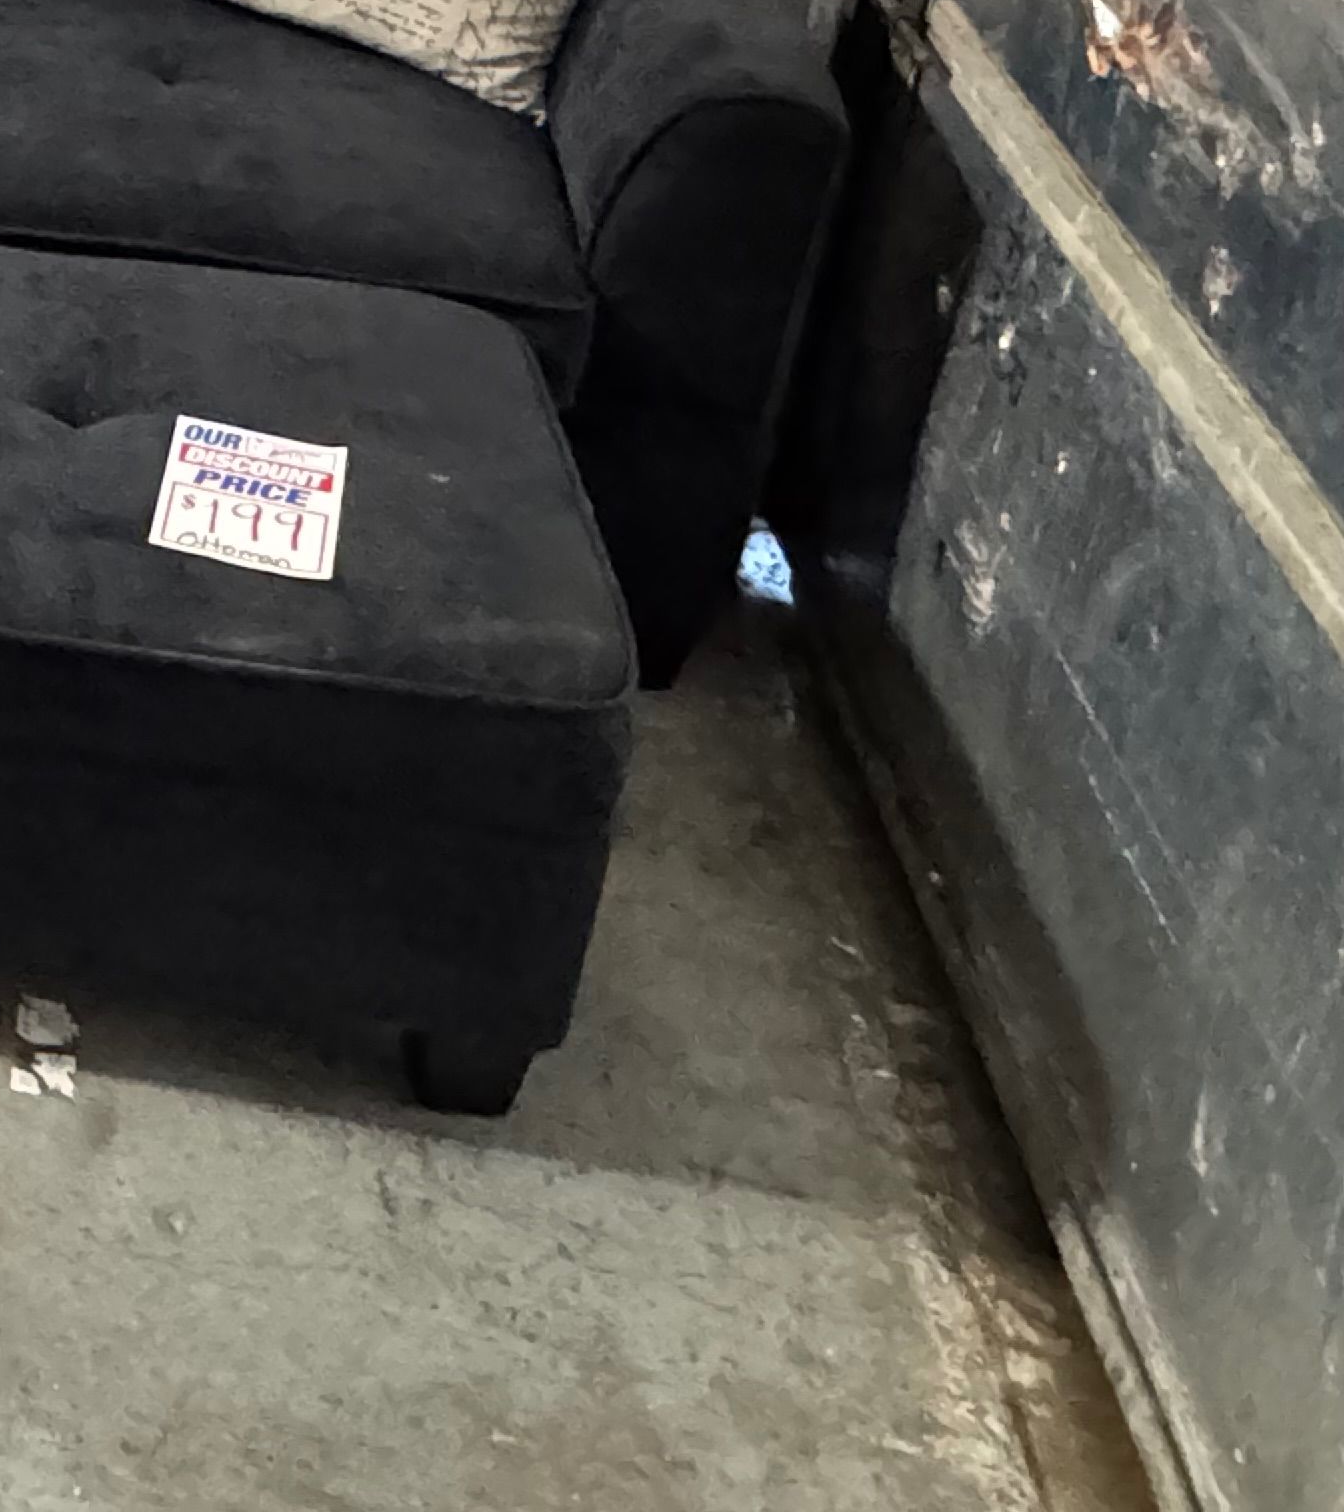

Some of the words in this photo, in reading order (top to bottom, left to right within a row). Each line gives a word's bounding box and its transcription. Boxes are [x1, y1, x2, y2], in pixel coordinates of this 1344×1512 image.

[184, 424, 243, 450] OUR
[184, 444, 325, 491] DISCOUNT
[193, 468, 312, 508] PRICE
